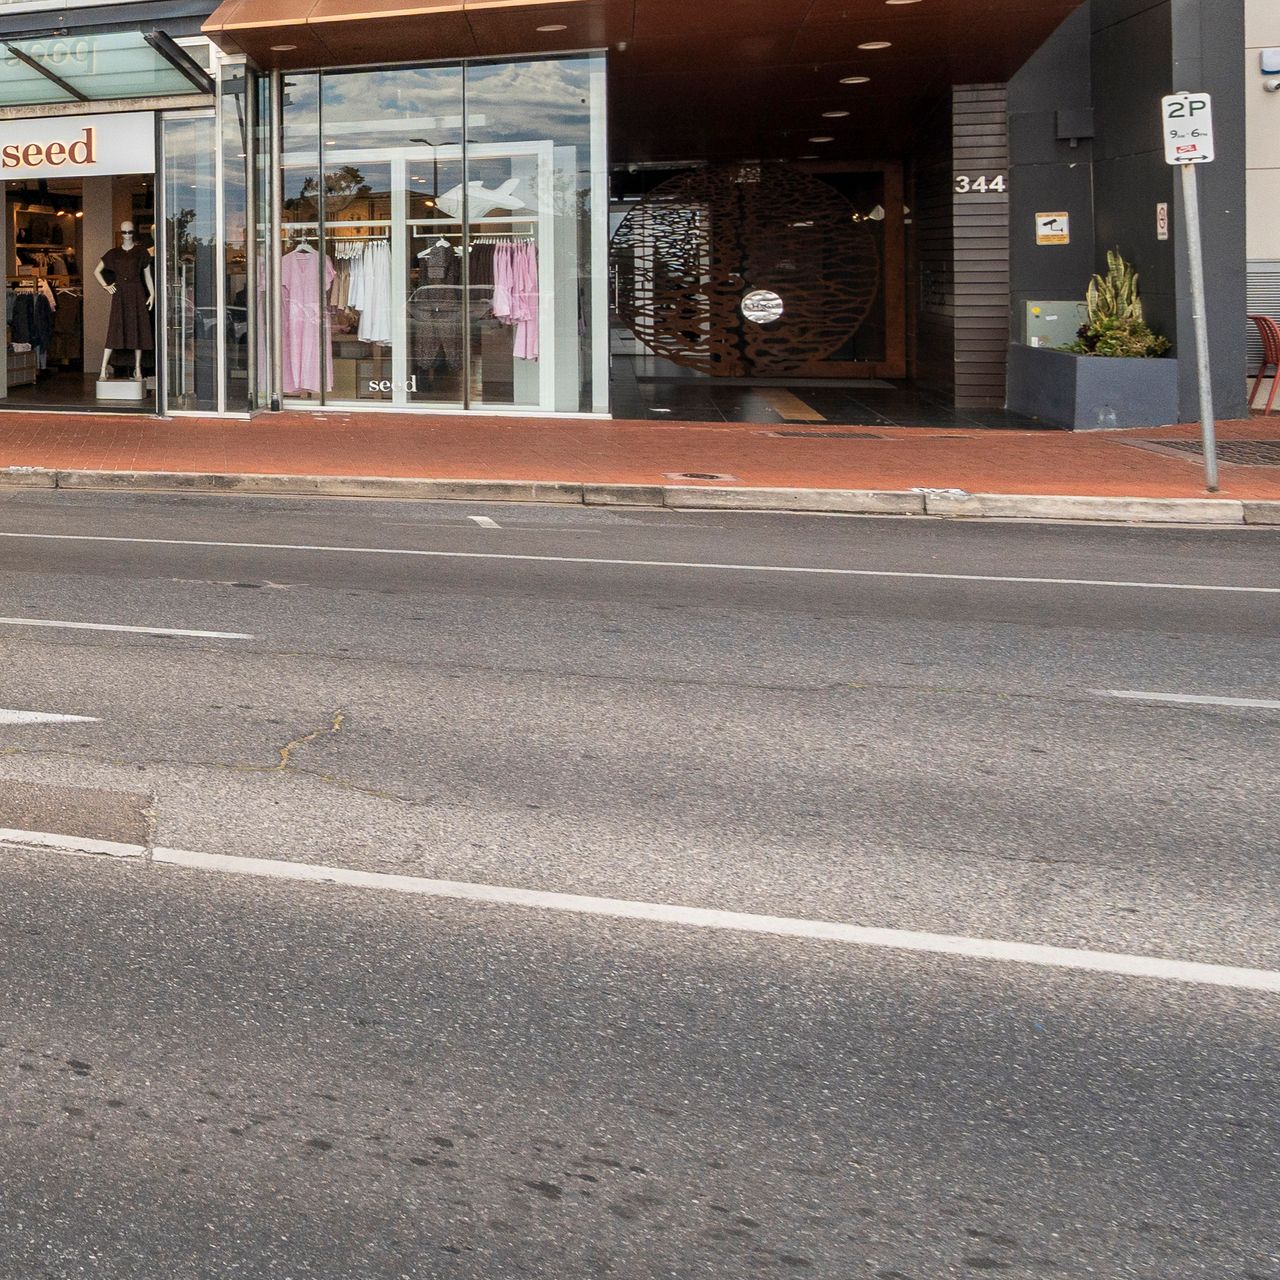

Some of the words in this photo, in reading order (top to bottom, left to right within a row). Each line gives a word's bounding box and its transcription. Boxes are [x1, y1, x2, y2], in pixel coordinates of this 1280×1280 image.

[1167, 100, 1207, 118] 2P
[2, 128, 96, 168] seed
[955, 175, 1006, 193] 344
[369, 375, 417, 392] seed
